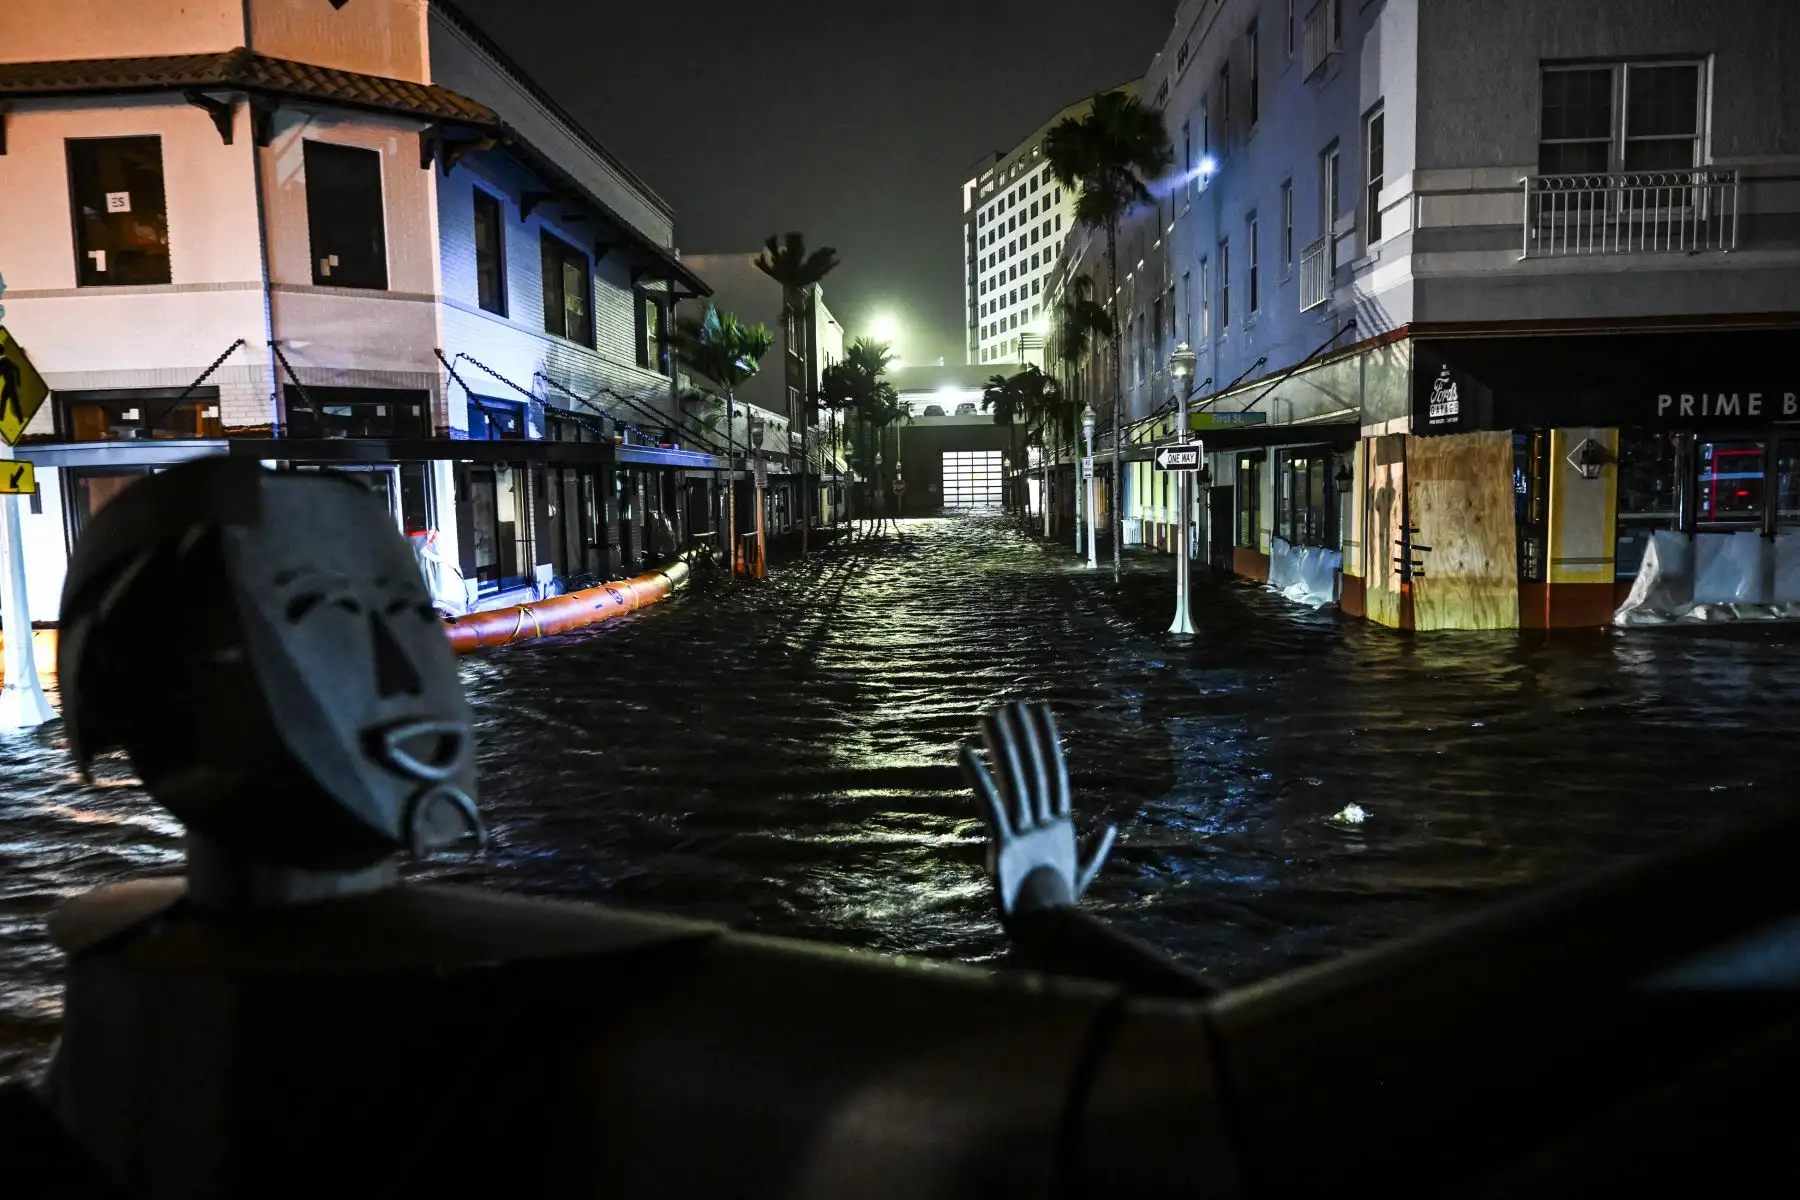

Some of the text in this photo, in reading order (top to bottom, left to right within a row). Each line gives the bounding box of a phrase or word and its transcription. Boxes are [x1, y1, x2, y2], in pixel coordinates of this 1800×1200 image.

[1657, 392, 1763, 417] PRIME
[1211, 413, 1231, 425] First
[1168, 452, 1195, 463] ONE WAY
